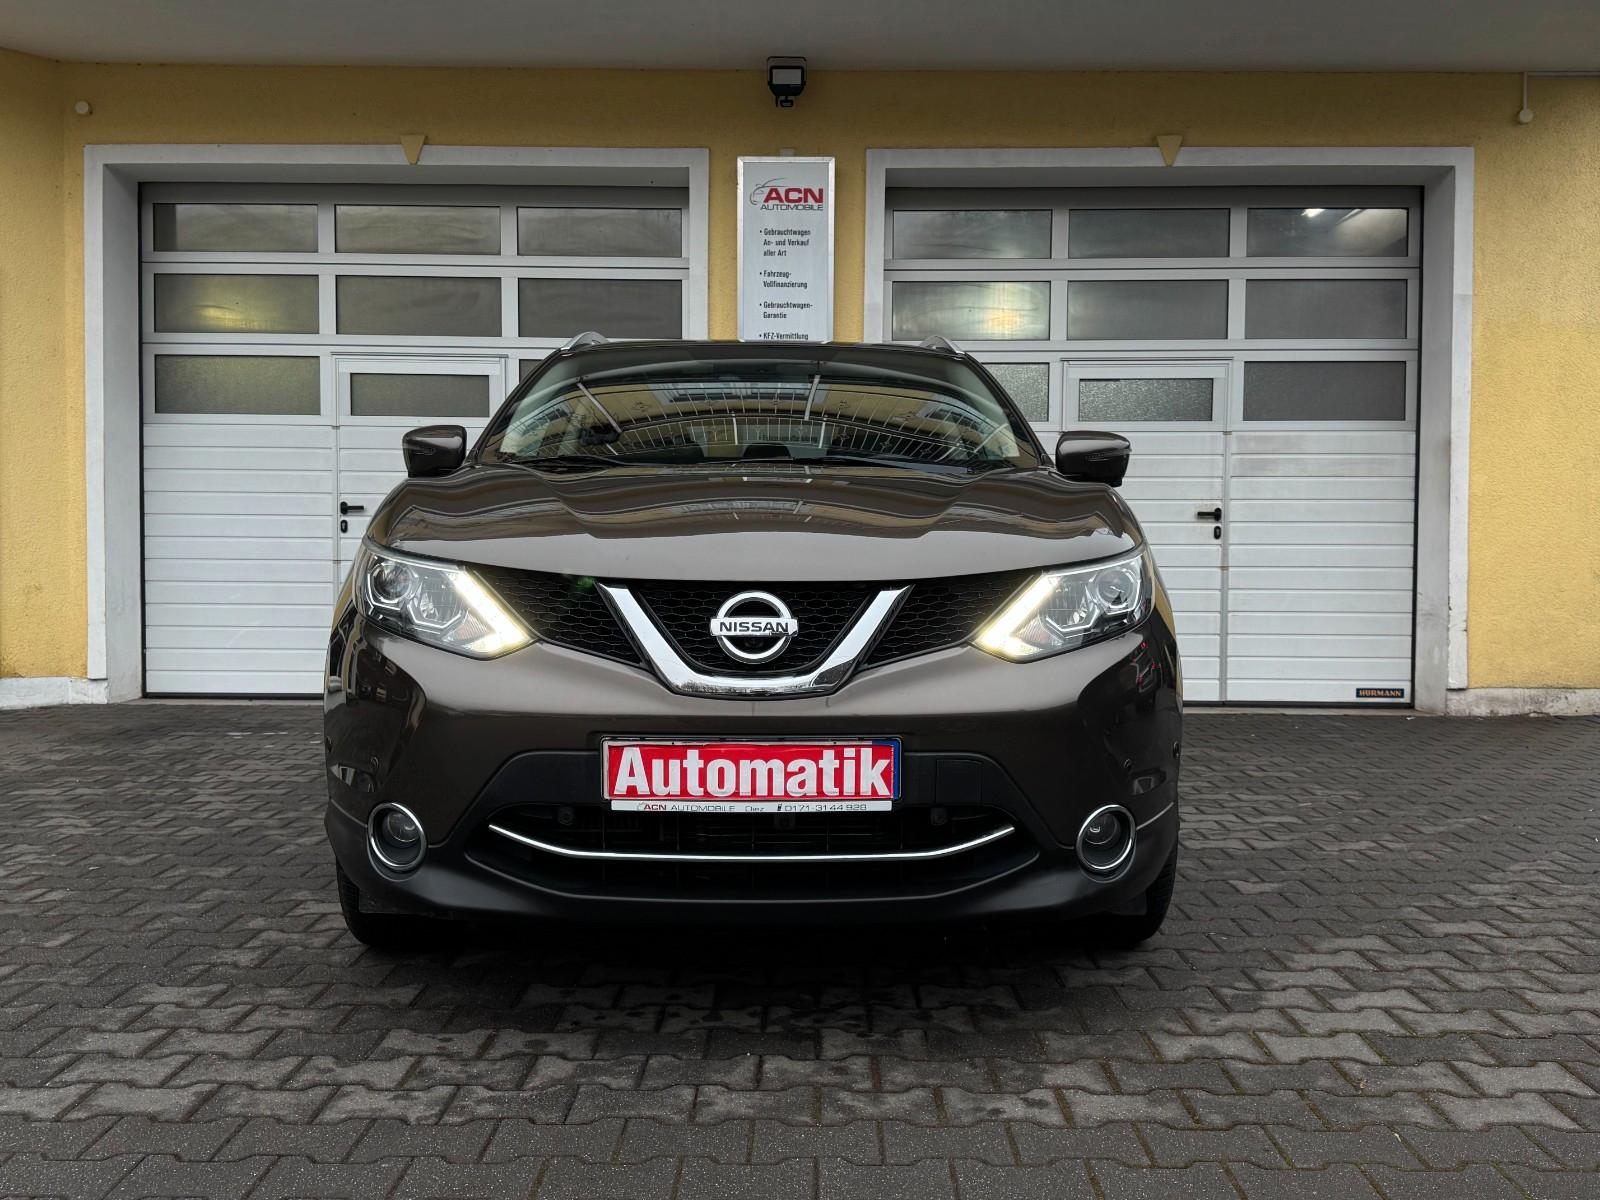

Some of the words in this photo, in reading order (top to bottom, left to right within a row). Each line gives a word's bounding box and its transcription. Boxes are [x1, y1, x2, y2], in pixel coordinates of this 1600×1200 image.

[763, 188, 824, 203] ACN
[760, 203, 824, 211] AUTOMOBILE
[763, 228, 811, 237] Gebrauchtwagen
[763, 238, 774, 246] An-
[775, 238, 786, 246] und
[787, 238, 810, 246] Verkauf
[763, 249, 776, 257] aller
[777, 249, 787, 257] Art
[763, 269, 792, 279] Fahrzeug-
[763, 280, 808, 289] Vollfinanzierung
[763, 301, 813, 310] Gebrauchtwagen-
[763, 311, 787, 319] Garantie
[763, 332, 809, 340] KFZ-Vermittlung
[719, 621, 789, 633] NISSAN
[613, 747, 891, 797] Automatik
[670, 804, 736, 812] AUTOMOBILE
